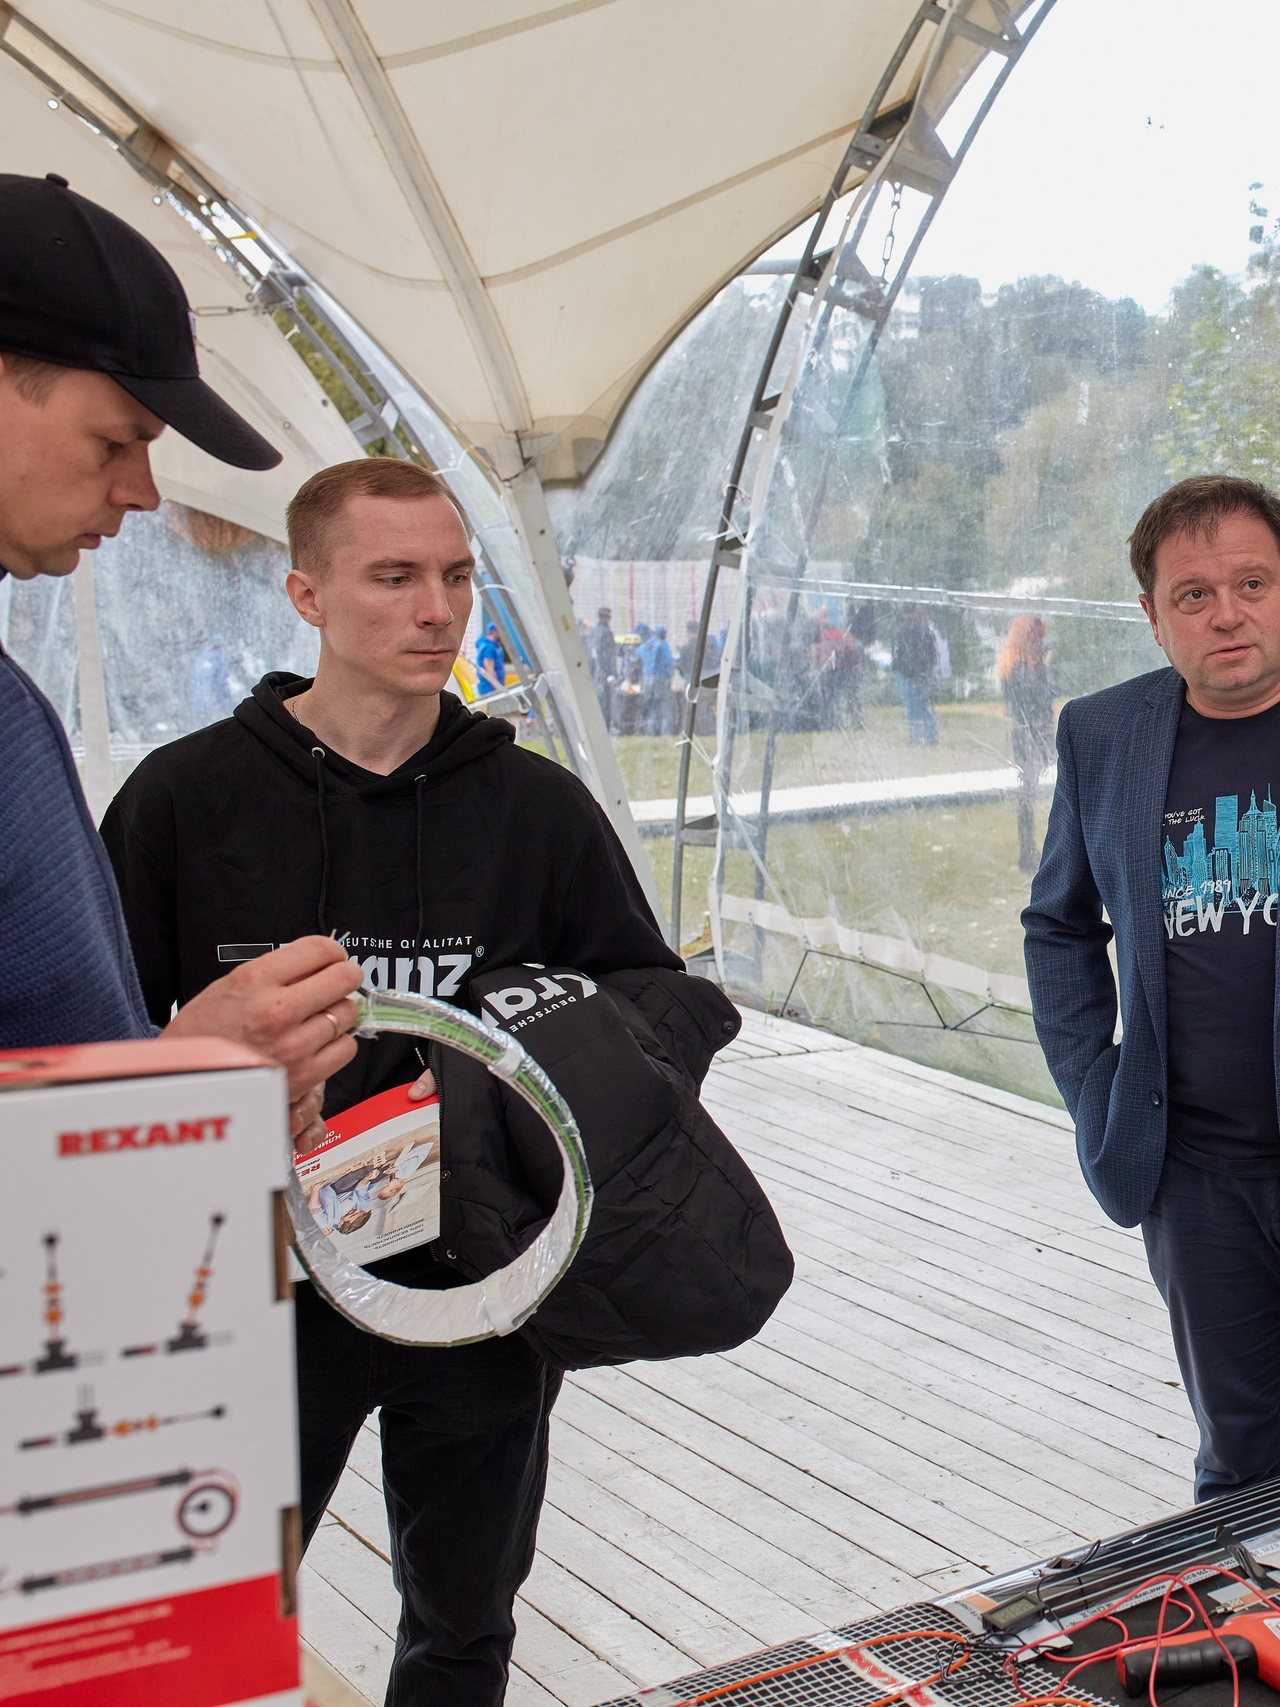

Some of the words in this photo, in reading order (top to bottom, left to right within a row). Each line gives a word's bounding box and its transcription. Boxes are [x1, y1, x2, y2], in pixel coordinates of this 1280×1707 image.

[1168, 817, 1182, 825] THE
[1185, 815, 1206, 823] LUCK
[1188, 807, 1203, 816] GOT
[1162, 885, 1195, 900] INCE
[1200, 879, 1232, 895] 1989
[509, 995, 577, 1033] DEUTSCHE
[57, 1115, 231, 1158] REXANT
